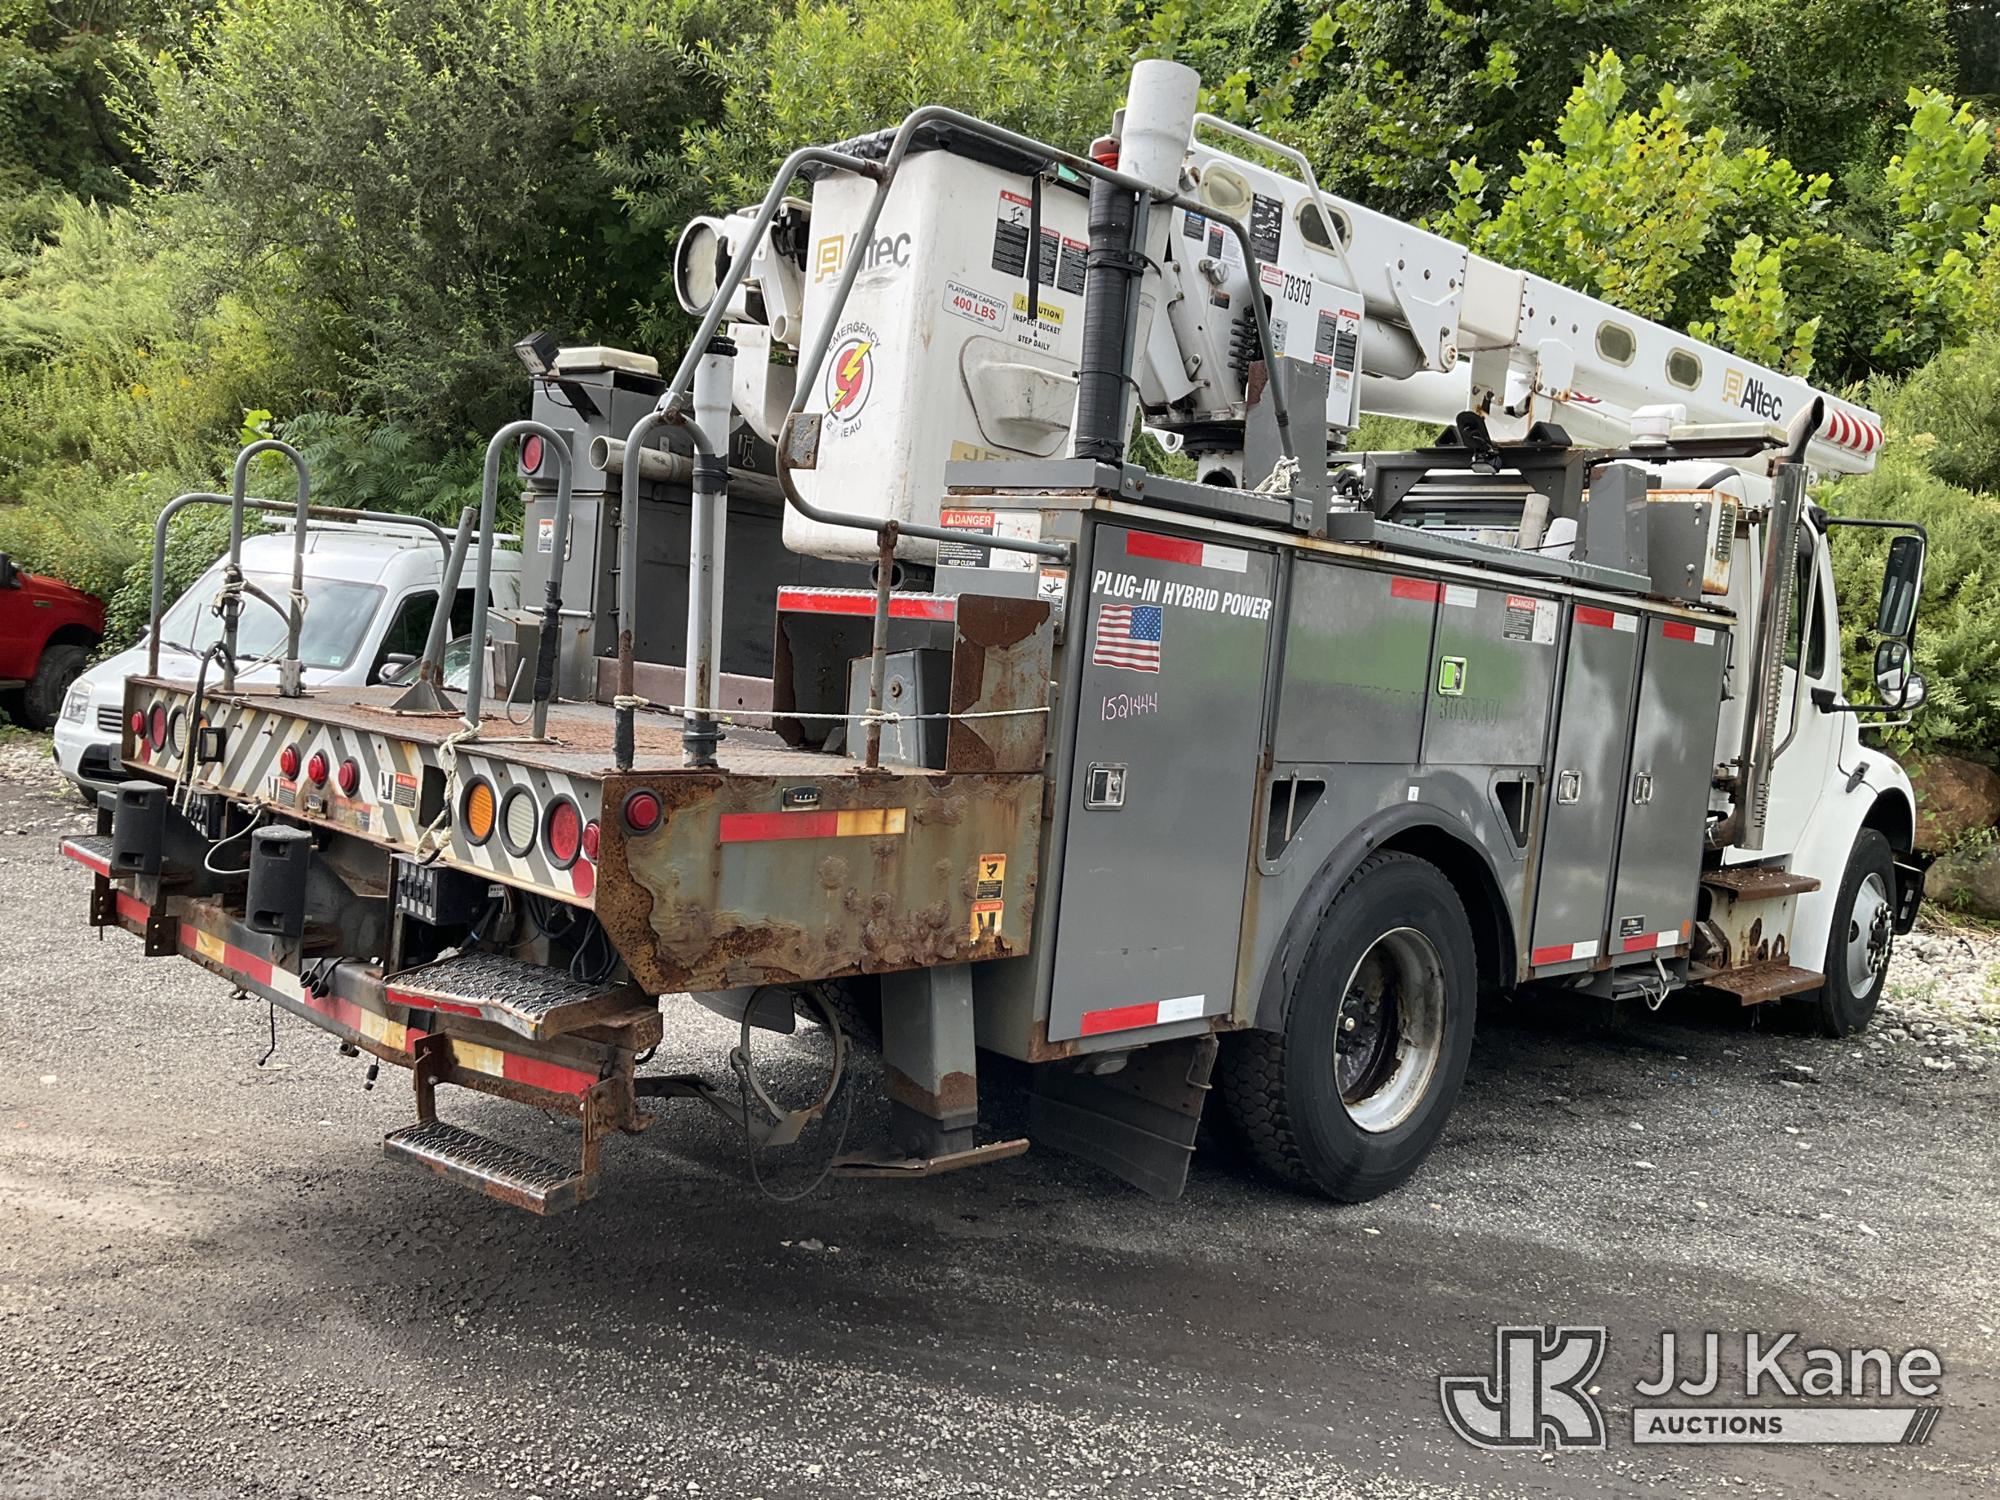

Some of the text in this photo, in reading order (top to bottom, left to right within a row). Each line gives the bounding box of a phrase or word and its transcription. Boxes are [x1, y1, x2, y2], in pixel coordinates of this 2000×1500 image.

[947, 283, 1005, 311] PLATFORM CAPACITY
[1283, 274, 1312, 306] 73379
[953, 296, 972, 311] 400
[974, 303, 996, 321] LBS
[1038, 306, 1061, 320] UTION
[828, 321, 881, 353] EMERGENCY
[1012, 312, 1061, 336] INSPECT BUCKET
[1017, 334, 1051, 352] STEP DAILY
[1740, 377, 1783, 422] Altec
[954, 514, 992, 526] DANGER
[1092, 569, 1161, 603] PLUG-IN
[1161, 581, 1219, 612] HYBRID
[1220, 592, 1272, 620] POWER
